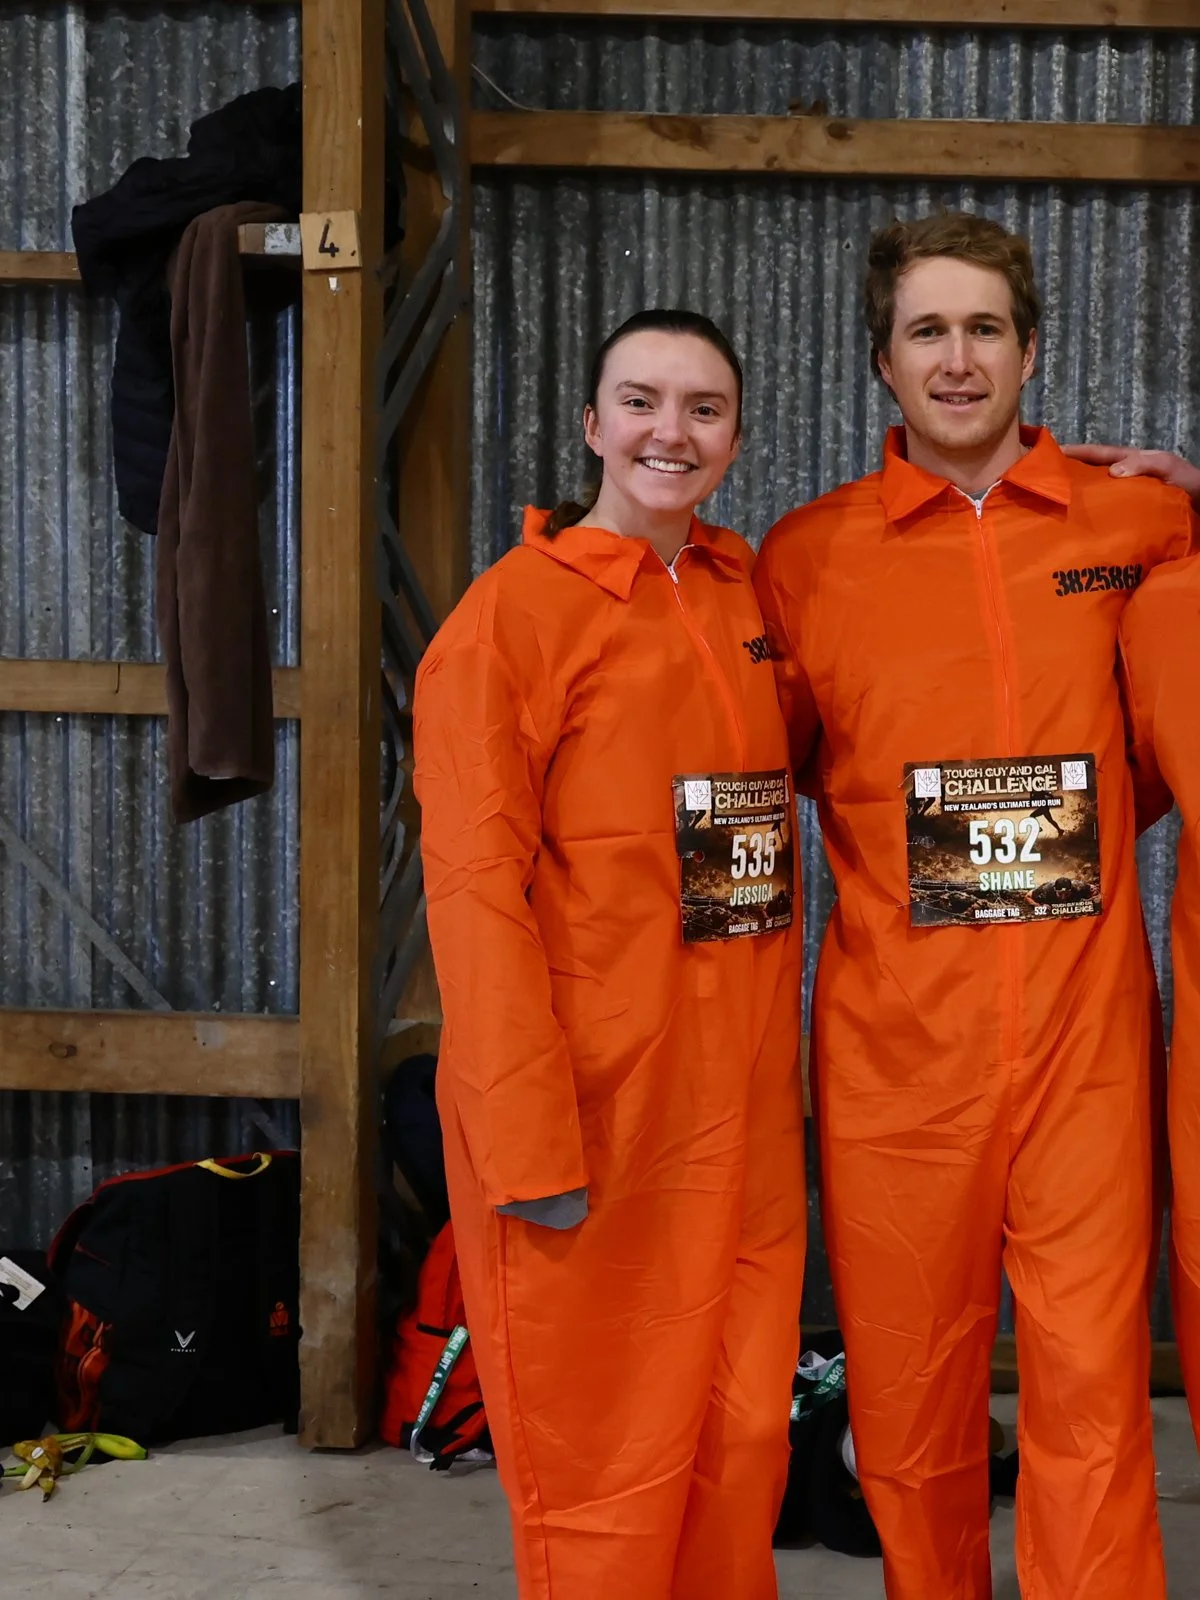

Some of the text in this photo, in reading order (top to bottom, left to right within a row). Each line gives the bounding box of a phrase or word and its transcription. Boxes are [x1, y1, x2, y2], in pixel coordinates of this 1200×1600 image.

[318, 218, 340, 258] 4
[944, 764, 1057, 779] TOUGH GUY AND GAL
[715, 781, 747, 792] TOUGH
[749, 780, 763, 791] GUY
[944, 774, 1058, 796] CHALLENGE
[715, 789, 784, 809] CHALLENGE
[944, 798, 1061, 812] NEW ZEALAND'S ULTIMATE MUD RUN
[714, 817, 727, 825] NEW
[969, 817, 1042, 865] 532
[731, 831, 776, 880] 535
[979, 870, 1036, 892] SHANE
[729, 883, 773, 907] JESSICA
[975, 906, 1047, 919] BAGGAGE TAG 532
[1051, 905, 1094, 915] CHALLENGE
